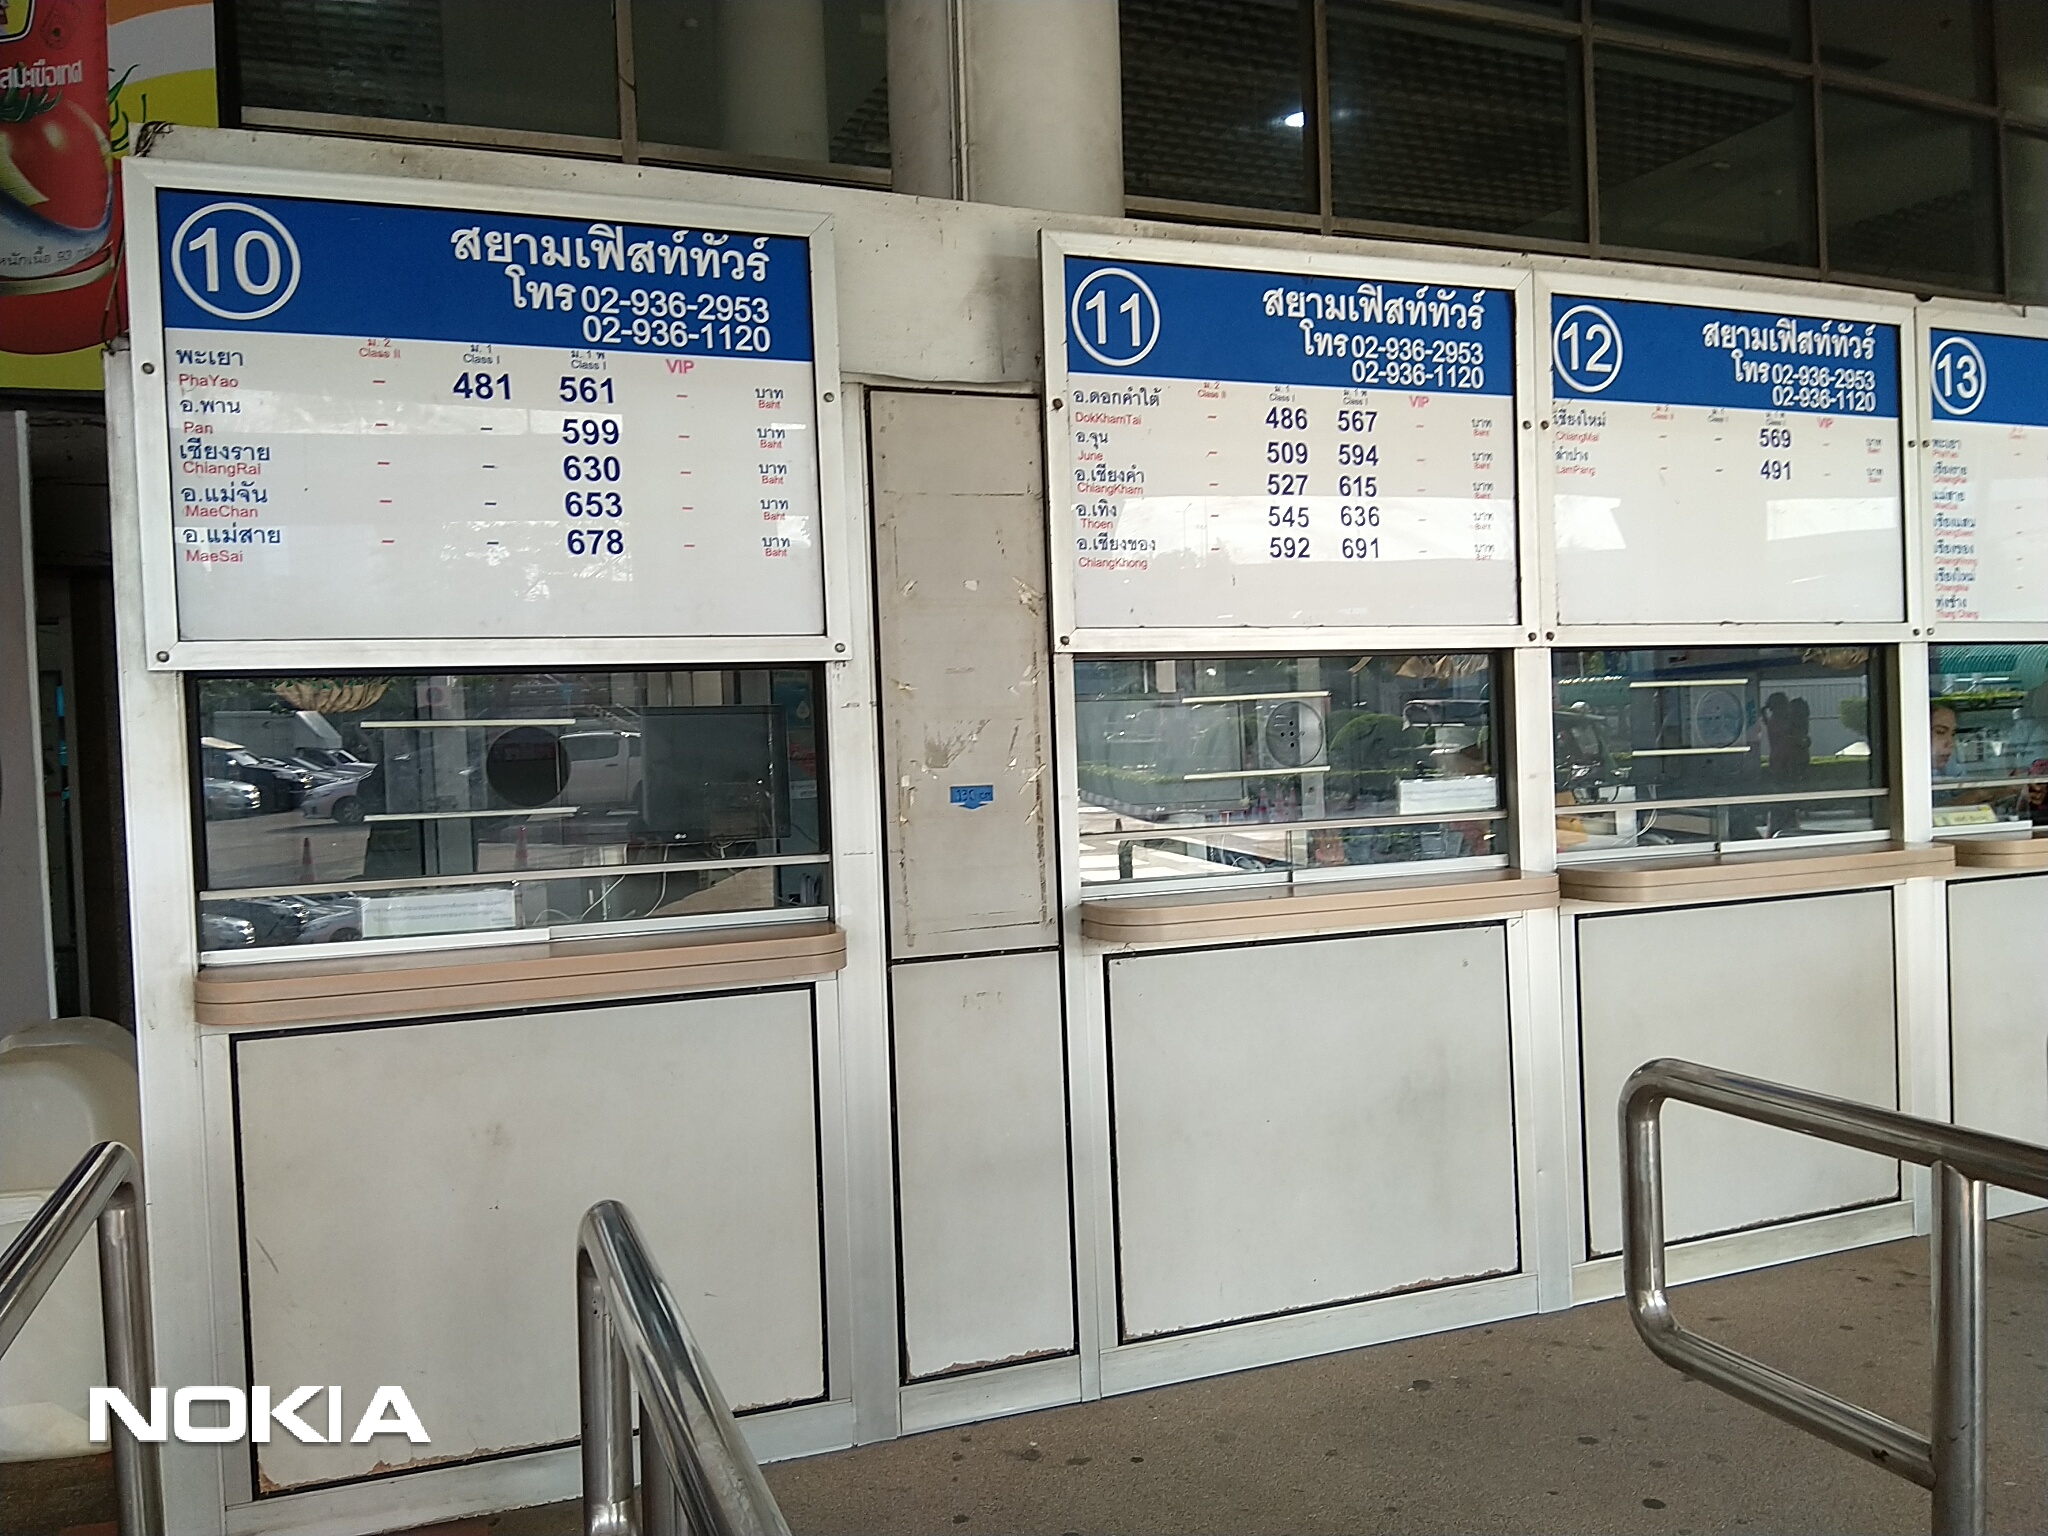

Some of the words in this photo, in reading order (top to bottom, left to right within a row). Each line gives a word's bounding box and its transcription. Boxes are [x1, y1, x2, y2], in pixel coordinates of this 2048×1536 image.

[188, 227, 281, 295] 10
[505, 263, 576, 312] โทร
[581, 285, 769, 324] 02-936-2953
[1085, 290, 1141, 347] 11
[582, 315, 771, 352] 02-936-1120
[1299, 318, 1349, 357] โทร
[1351, 335, 1484, 365] 02-936-2953
[359, 347, 390, 358] Class
[1561, 322, 1613, 373] 12
[176, 349, 244, 367] พะเยา
[463, 353, 493, 364] Class
[571, 359, 601, 370] Class
[666, 359, 694, 374] VIP
[1352, 359, 1485, 389] 02-936-1120
[1731, 349, 1771, 384] โทร
[1772, 363, 1875, 391] 02-936-2953
[1937, 353, 1979, 398] 13
[179, 374, 239, 388] PhaYao
[453, 372, 510, 400] 481
[559, 376, 614, 404] 561
[755, 388, 783, 399] บาท
[1073, 386, 1162, 406] อ.ดอกคำใต้
[1409, 395, 1430, 408] VIP
[1772, 385, 1876, 412] 02-936-1120
[180, 399, 241, 414] อ.พาน
[758, 400, 780, 409] Baht
[184, 422, 213, 434] Pan
[1075, 412, 1142, 425] DokKhamTai
[1266, 407, 1308, 430] 486
[1338, 410, 1378, 432] 567
[562, 418, 620, 445] 599
[757, 428, 785, 439] บาท
[1076, 431, 1108, 449] อ.จุน
[1759, 428, 1791, 448] 569
[180, 437, 270, 461] เชียงราย
[760, 440, 782, 449] Baht
[1267, 442, 1308, 464] 509
[1077, 450, 1103, 461] June
[1338, 444, 1379, 466] 594
[183, 461, 261, 477] ChiangRai
[563, 455, 621, 482] 630
[758, 463, 787, 475] บาท
[1074, 463, 1145, 483] อ.เชียงคำ
[1760, 460, 1791, 480] 491
[761, 475, 784, 484] Baht
[1077, 483, 1144, 496] ChiangKham
[1268, 474, 1309, 496] 527
[1339, 476, 1377, 497] 615
[181, 481, 268, 503] อ.แม่จัน
[185, 505, 258, 517] MaeChan
[564, 491, 623, 518] 653
[760, 499, 788, 510] บาท
[1075, 498, 1117, 517] อ.เทิง
[763, 512, 786, 521] Baht
[1080, 518, 1114, 529] Thoen
[1268, 506, 1309, 528] 545
[1341, 505, 1380, 527] 636
[183, 522, 281, 544] อ.แม่สาย
[567, 529, 624, 555] 678
[762, 536, 790, 548] บาท
[186, 550, 243, 563] MaeSai
[765, 548, 788, 557] Baht
[1270, 537, 1311, 559] 592
[1342, 537, 1379, 559] 691
[1078, 557, 1148, 570] ChiangKhong
